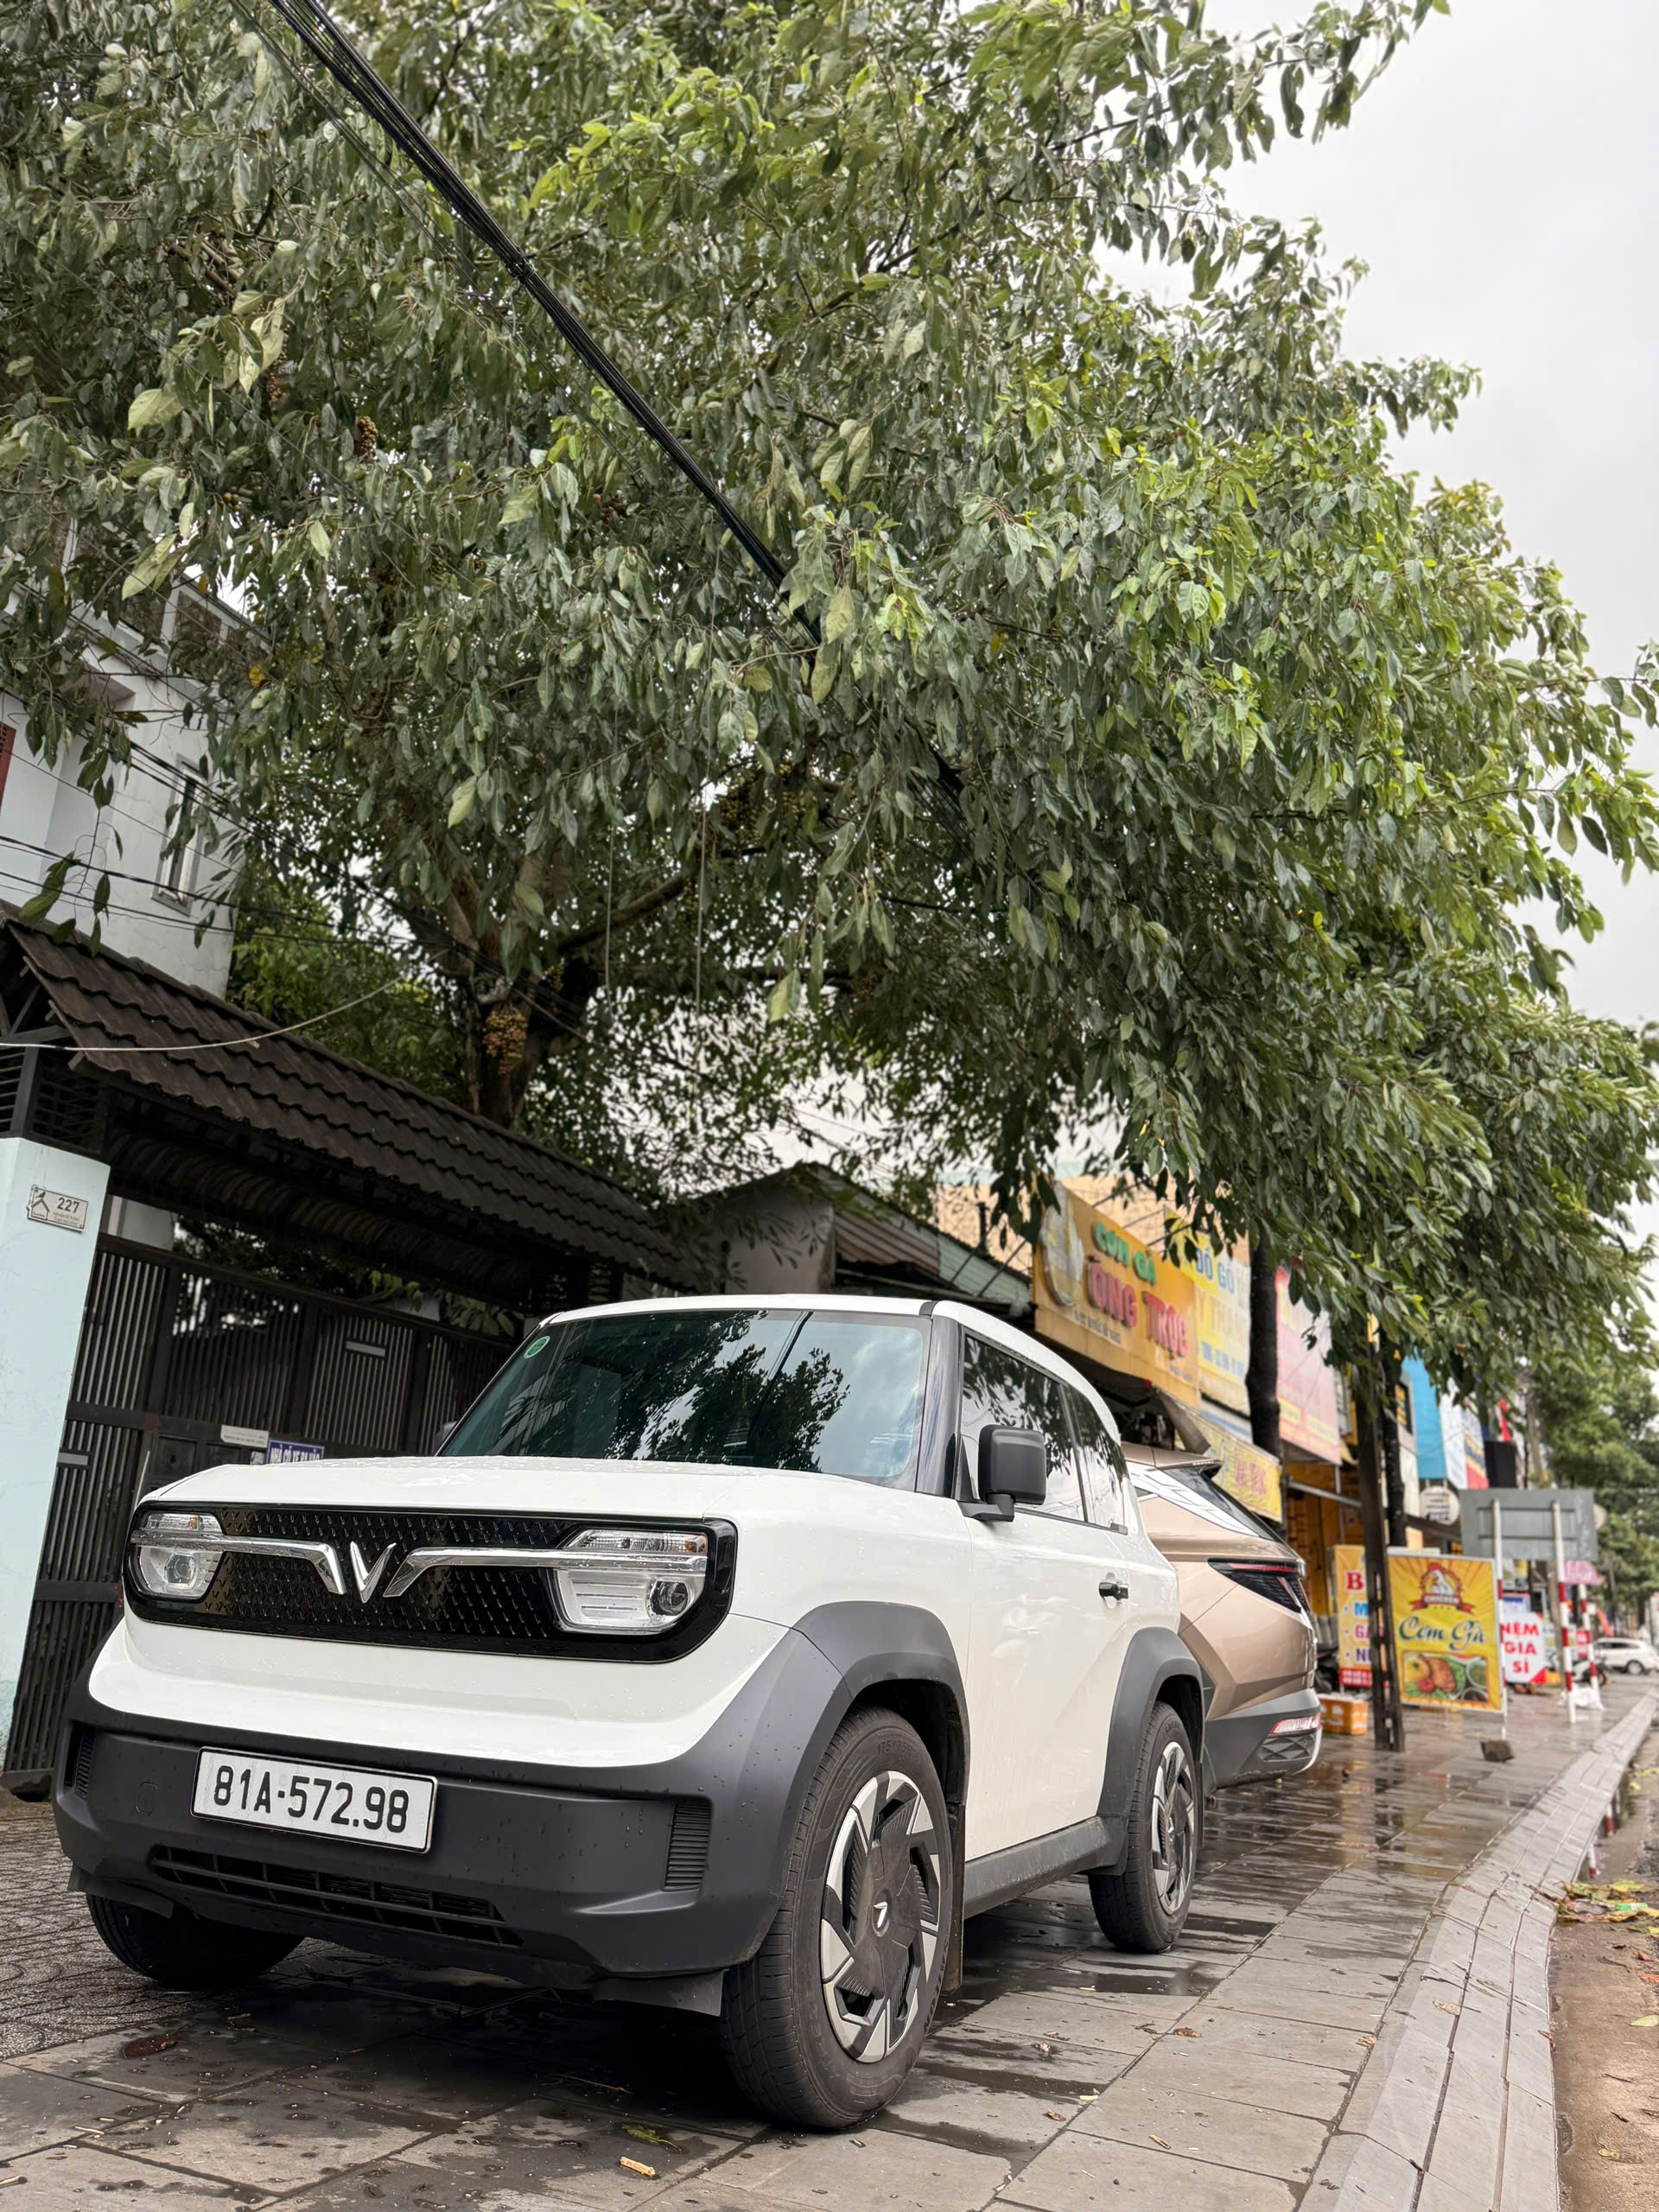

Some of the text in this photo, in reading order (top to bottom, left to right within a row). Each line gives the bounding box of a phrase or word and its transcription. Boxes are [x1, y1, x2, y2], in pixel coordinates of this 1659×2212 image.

[57, 1198, 80, 1213] 227
[1088, 1255, 1138, 1328] ÔNG
[213, 1764, 410, 1834] 81A-572.98
